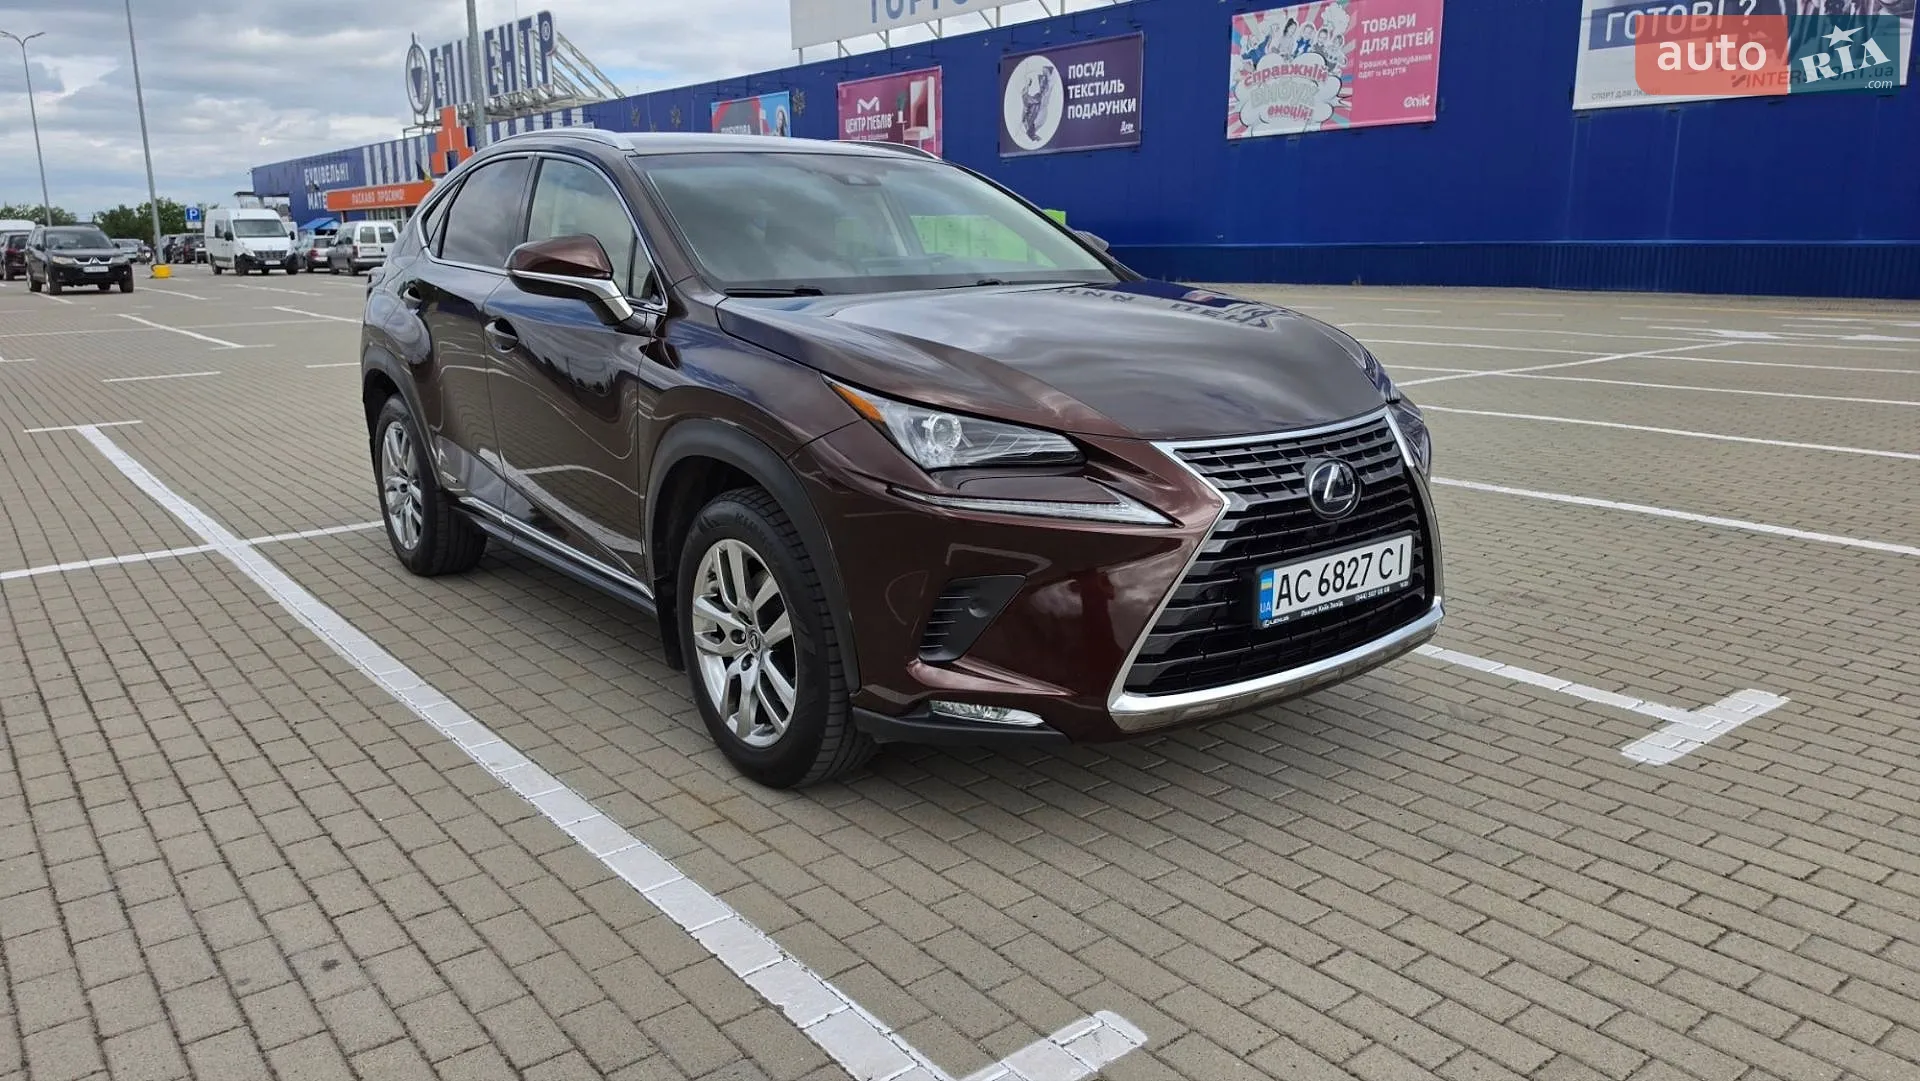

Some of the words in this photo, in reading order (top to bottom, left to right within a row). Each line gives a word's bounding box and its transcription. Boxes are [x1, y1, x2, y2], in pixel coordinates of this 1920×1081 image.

[1361, 13, 1416, 34] ТОВАРИ
[1360, 37, 1389, 56] ДЛЯ
[1391, 27, 1434, 52] ДІТЕЙ
[1068, 61, 1105, 79] ПОСУД
[1067, 79, 1125, 100] ТЕКСТИЛЬ
[1067, 98, 1137, 119] ПОДАРУНКИ
[845, 117, 866, 134] ЦЕНТР
[304, 162, 349, 186] БУДІВЕЛЬНІ
[190, 210, 198, 220] P
[1276, 569, 1312, 610] AC
[1317, 552, 1374, 597] 6827
[1260, 602, 1272, 613] UA
